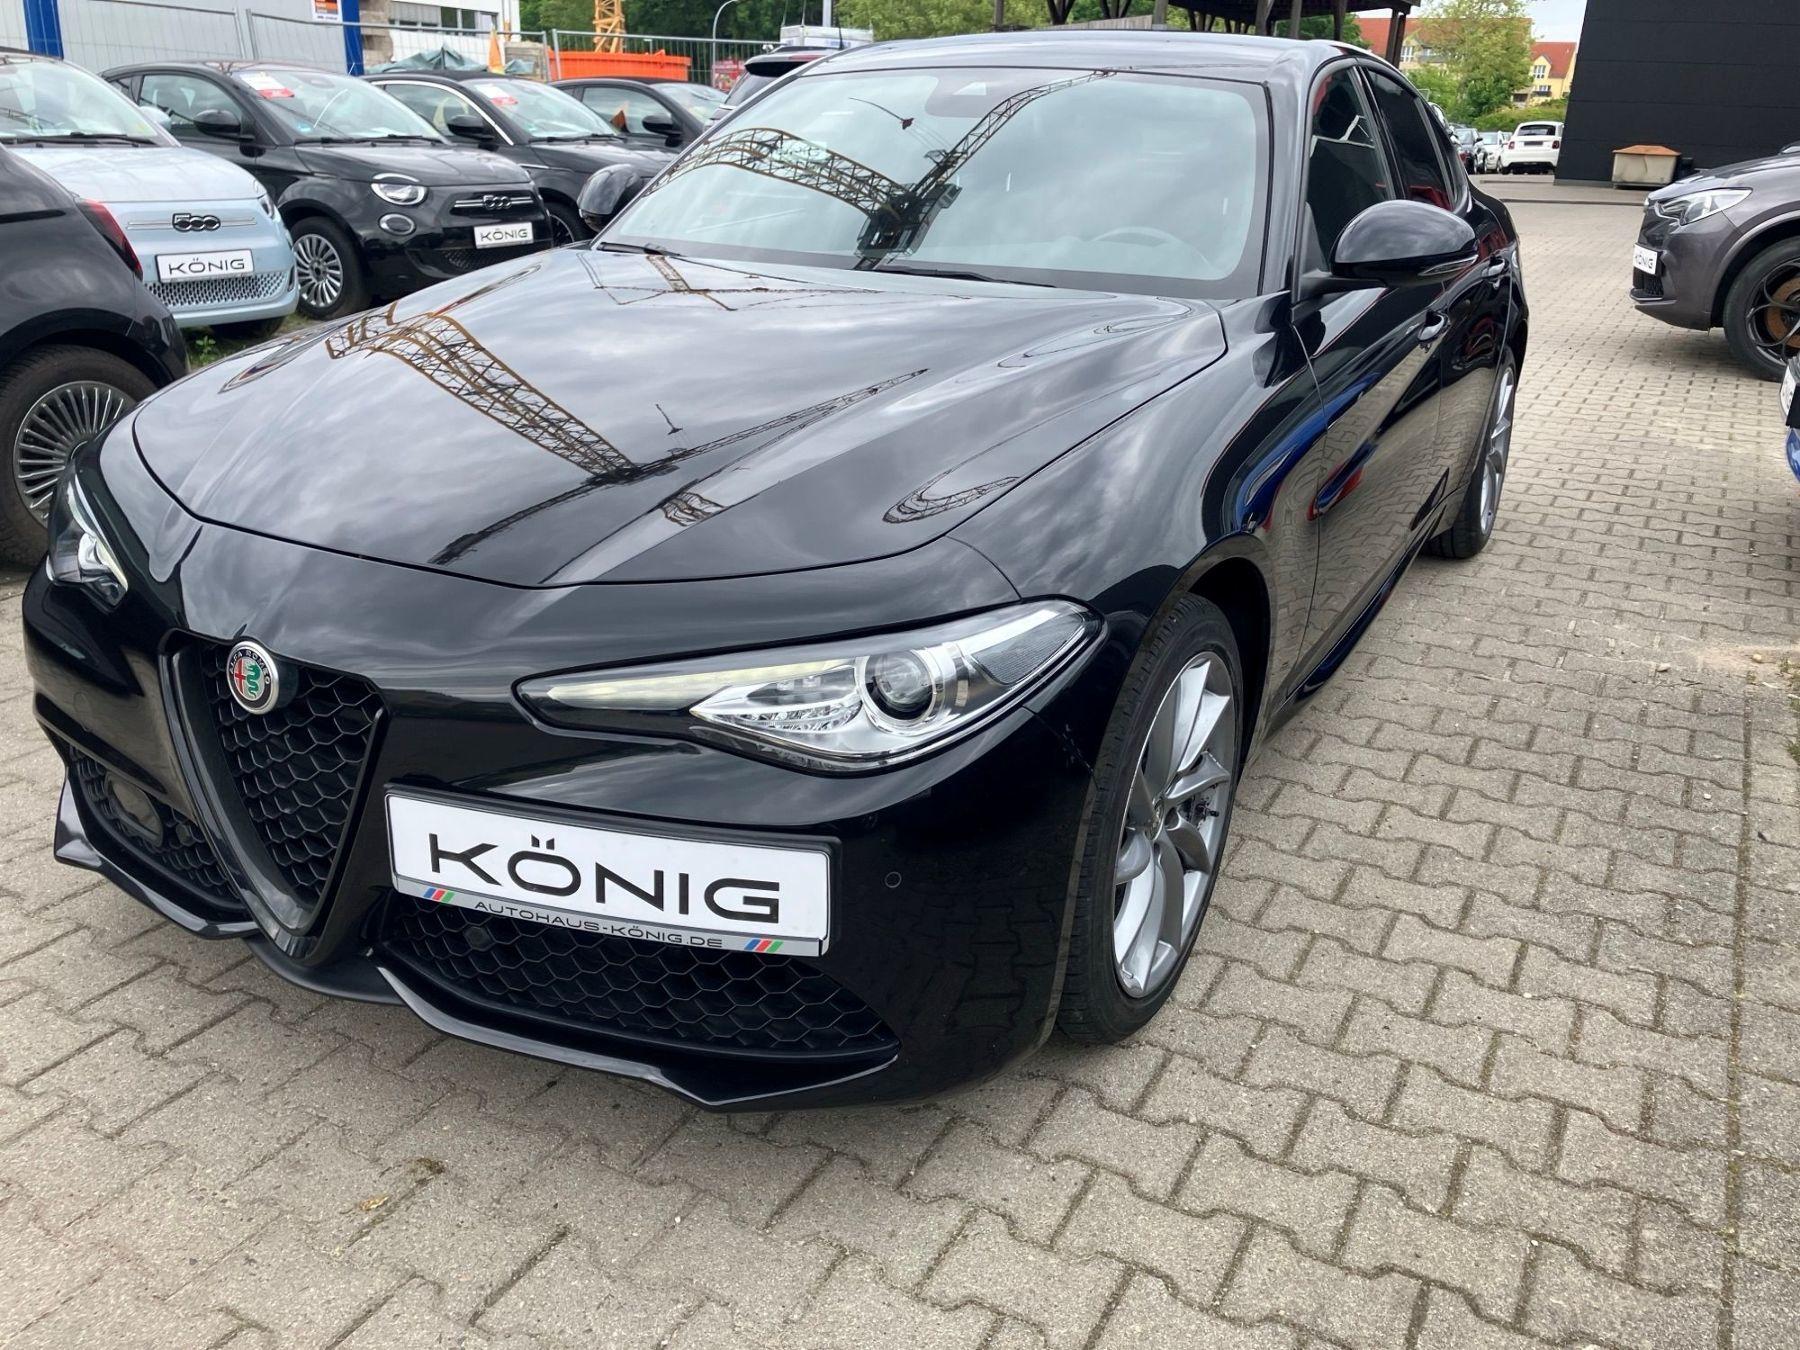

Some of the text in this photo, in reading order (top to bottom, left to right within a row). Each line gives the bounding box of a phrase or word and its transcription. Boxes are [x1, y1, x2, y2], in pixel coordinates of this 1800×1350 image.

[482, 194, 512, 211] 500
[172, 213, 221, 232] 500
[480, 228, 528, 242] KÖNIG
[168, 257, 245, 275] KÖNIG
[230, 650, 271, 685] ALFA ROMEO
[428, 833, 780, 924] KÖNIG
[475, 901, 723, 948] AUTOHAUS-KÖNIG.DE
